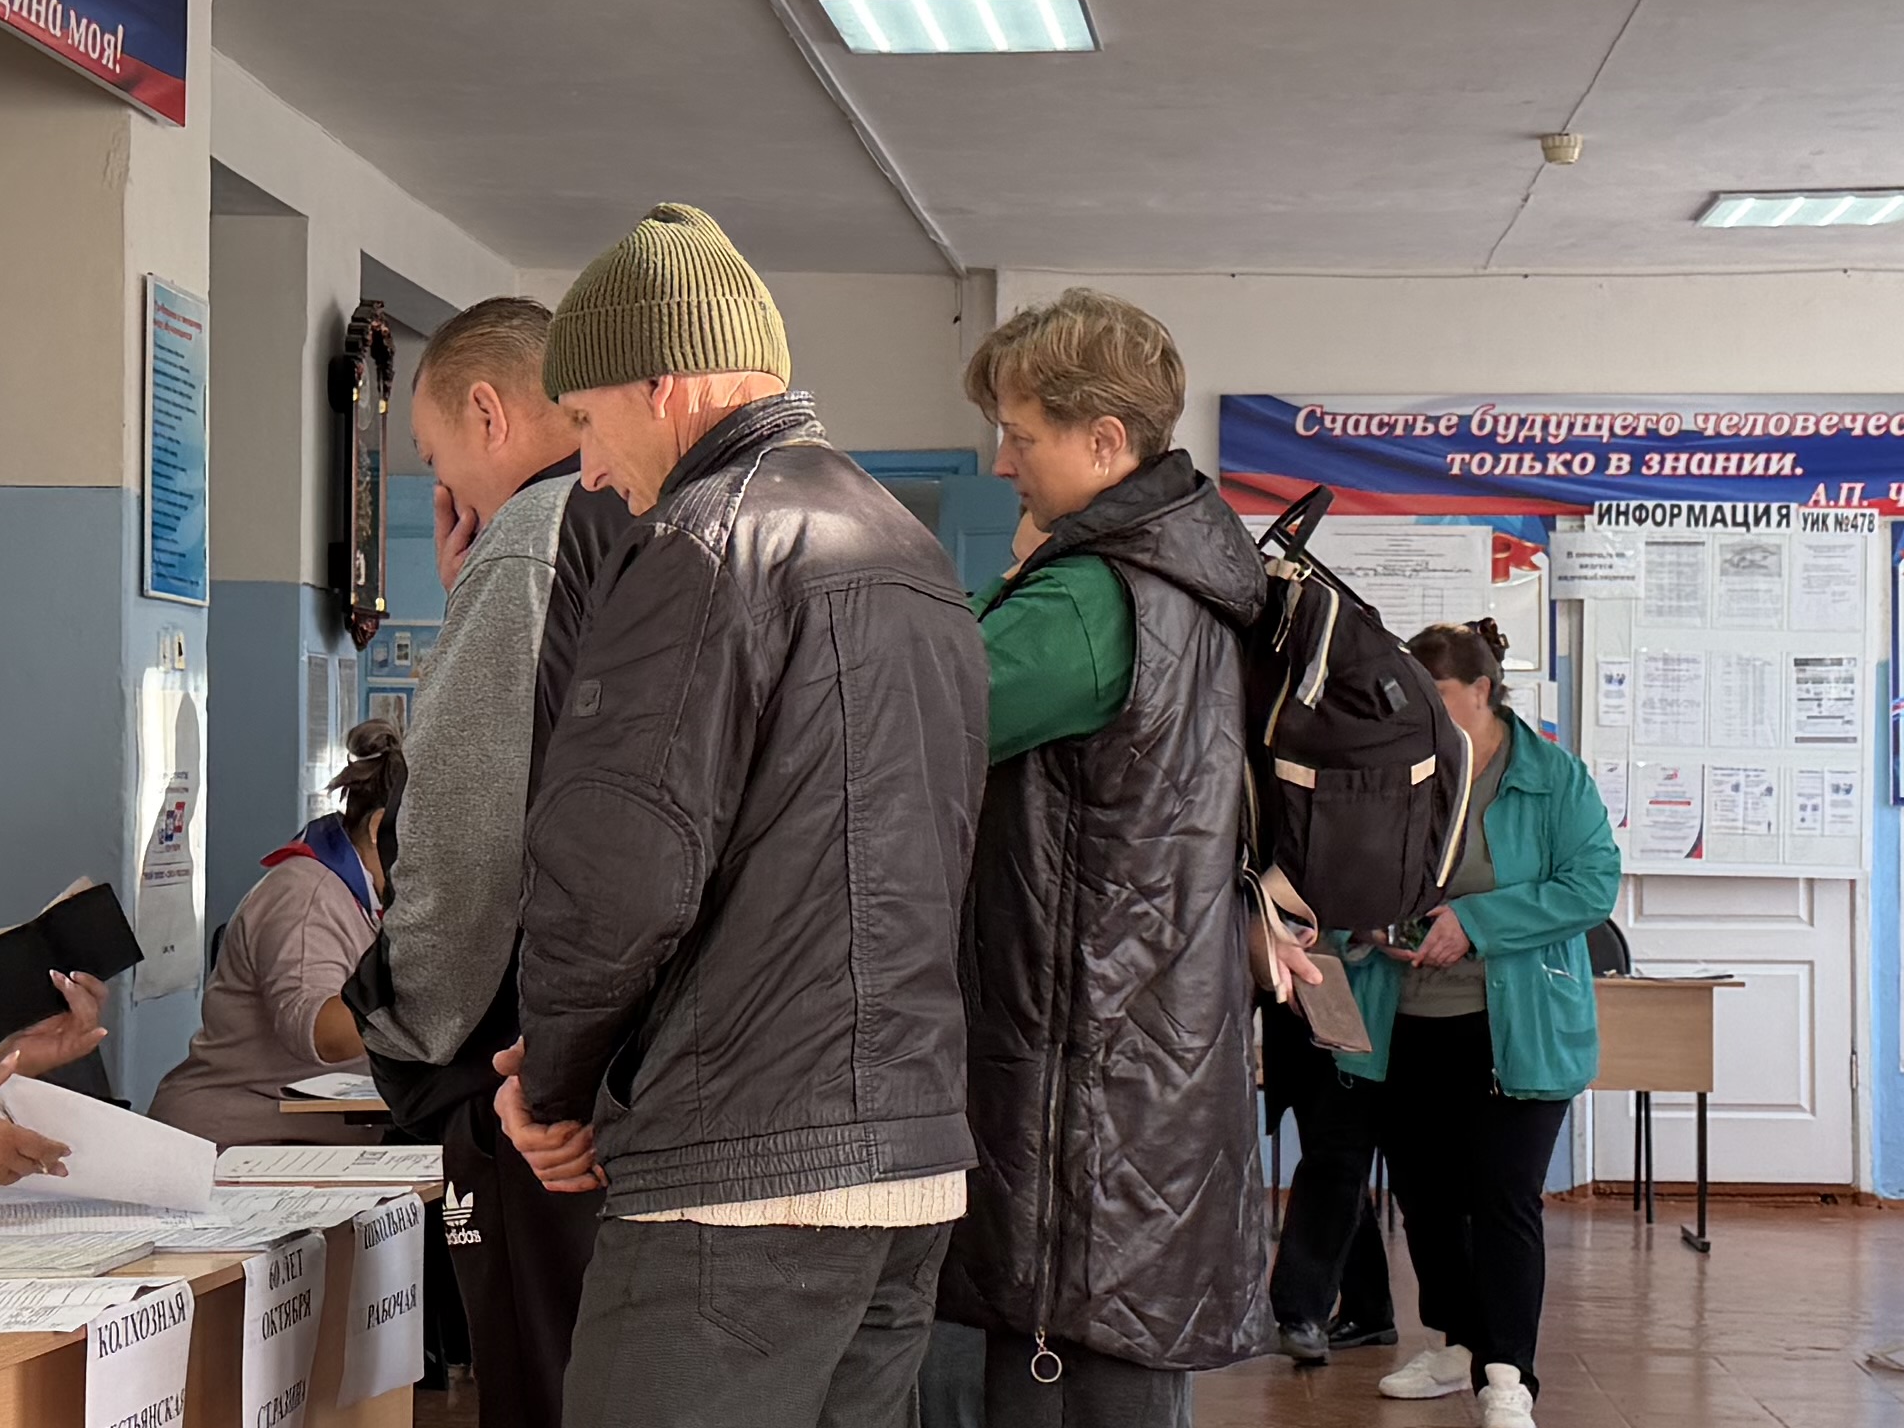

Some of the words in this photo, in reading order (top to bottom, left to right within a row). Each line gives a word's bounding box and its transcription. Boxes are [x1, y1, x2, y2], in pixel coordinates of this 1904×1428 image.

[67, 8, 124, 74] моя!
[1293, 402, 1460, 442] Счастье
[1469, 403, 1684, 446] будущего
[1446, 451, 1597, 479] только
[1607, 452, 1633, 478] в
[1642, 450, 1804, 480] знании.
[1597, 502, 1791, 532] ИНФОРМАЦИЯ
[1807, 483, 1871, 509] А.П.
[1801, 511, 1829, 533] УИК
[1834, 511, 1876, 534] №478
[363, 1200, 419, 1250] ШКОЛЬНАЯ
[281, 1248, 304, 1286] ЛЕТ
[96, 1291, 187, 1360] КОЛХОЗНАЯ
[262, 1288, 311, 1341] ОКТЯБРЯ
[366, 1283, 417, 1330] РАБОЧАЯ
